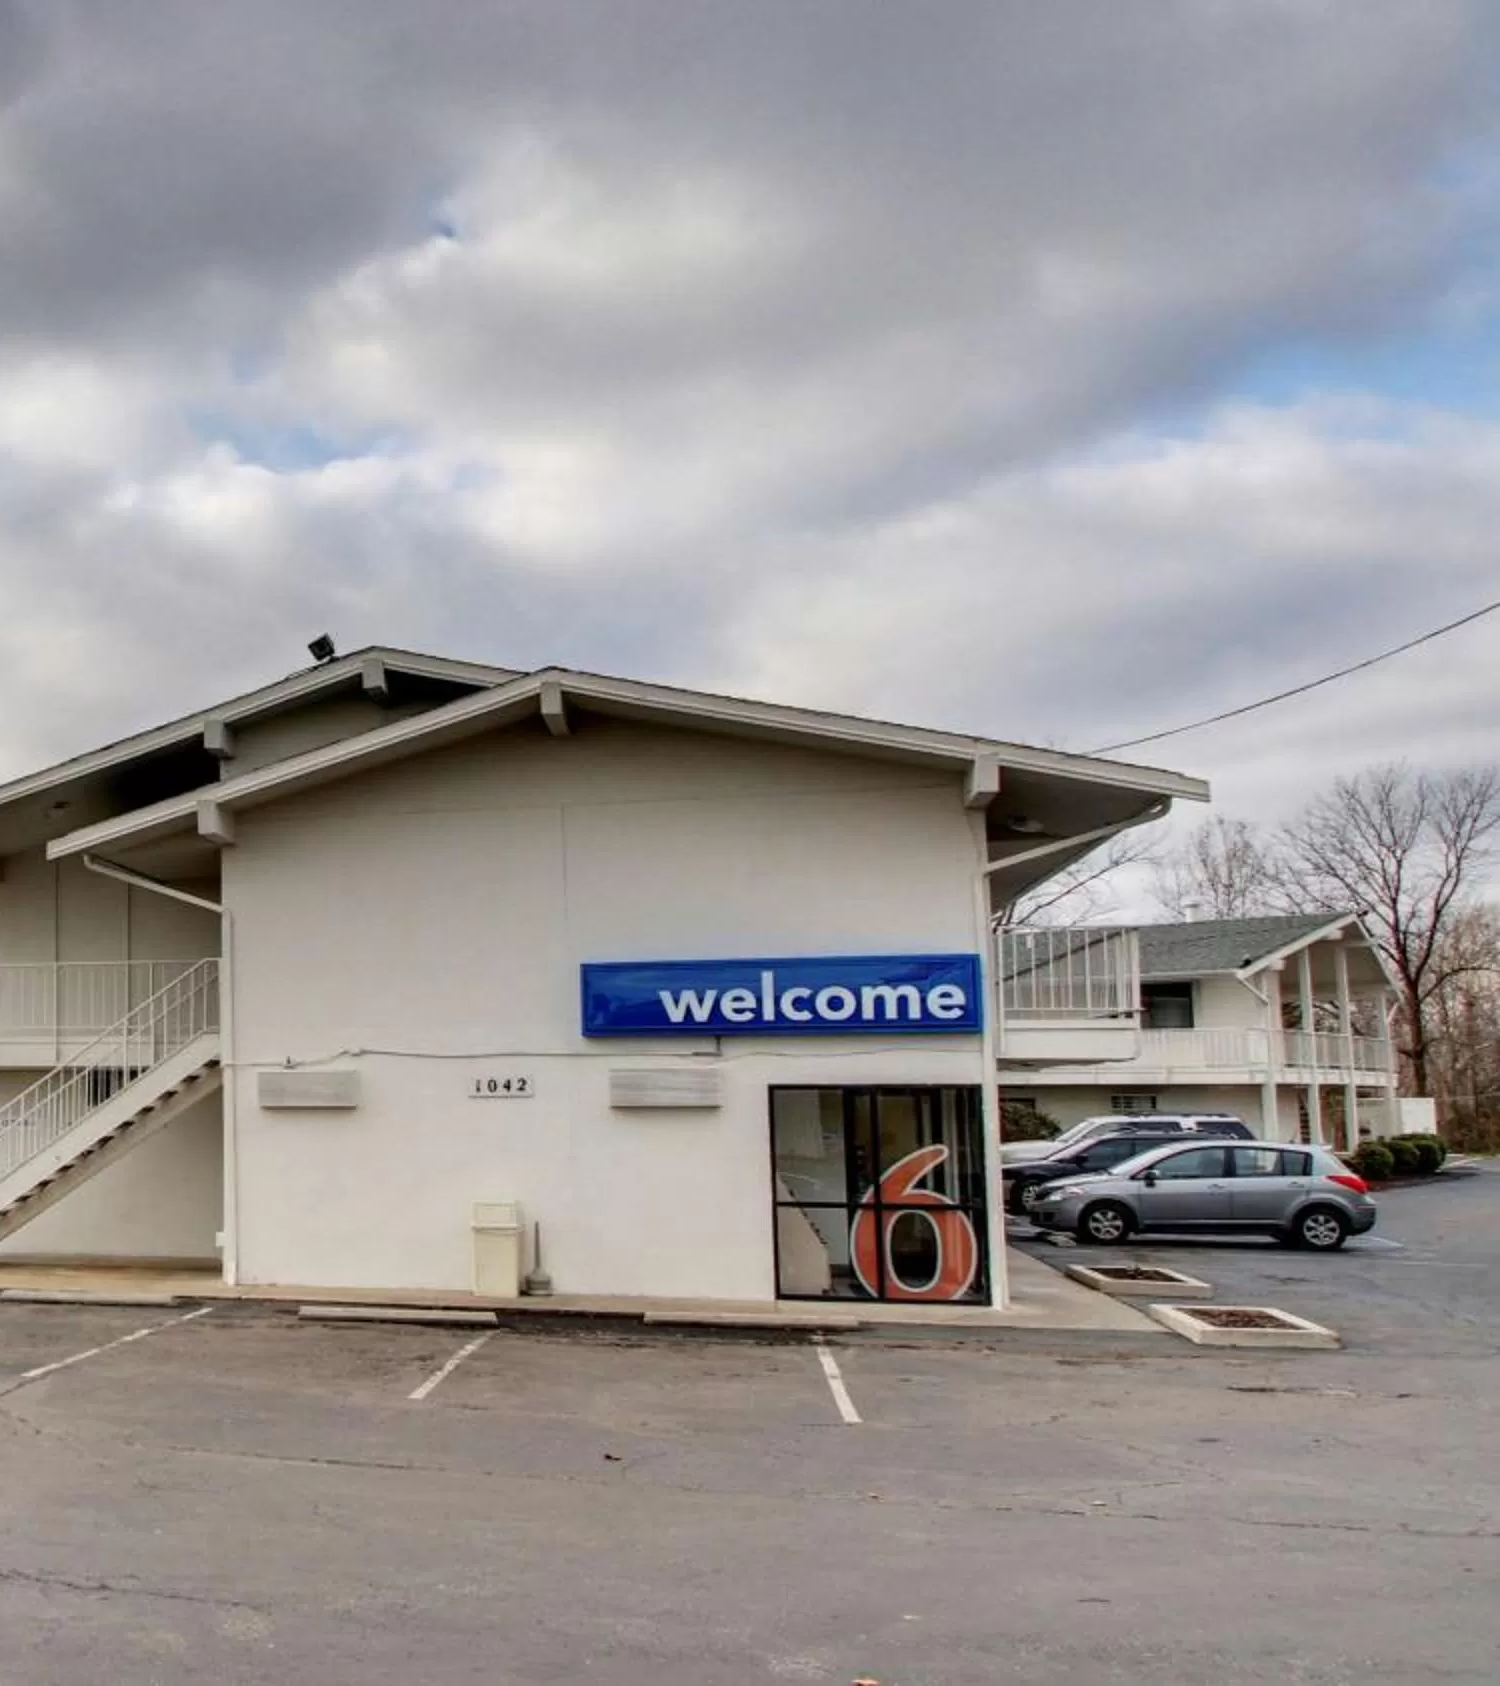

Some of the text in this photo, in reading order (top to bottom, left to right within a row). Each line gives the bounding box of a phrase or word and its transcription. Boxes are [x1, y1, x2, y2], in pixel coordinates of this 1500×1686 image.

[658, 970, 966, 1023] welcome
[474, 1077, 527, 1093] 1042
[850, 1143, 978, 1300] 6
